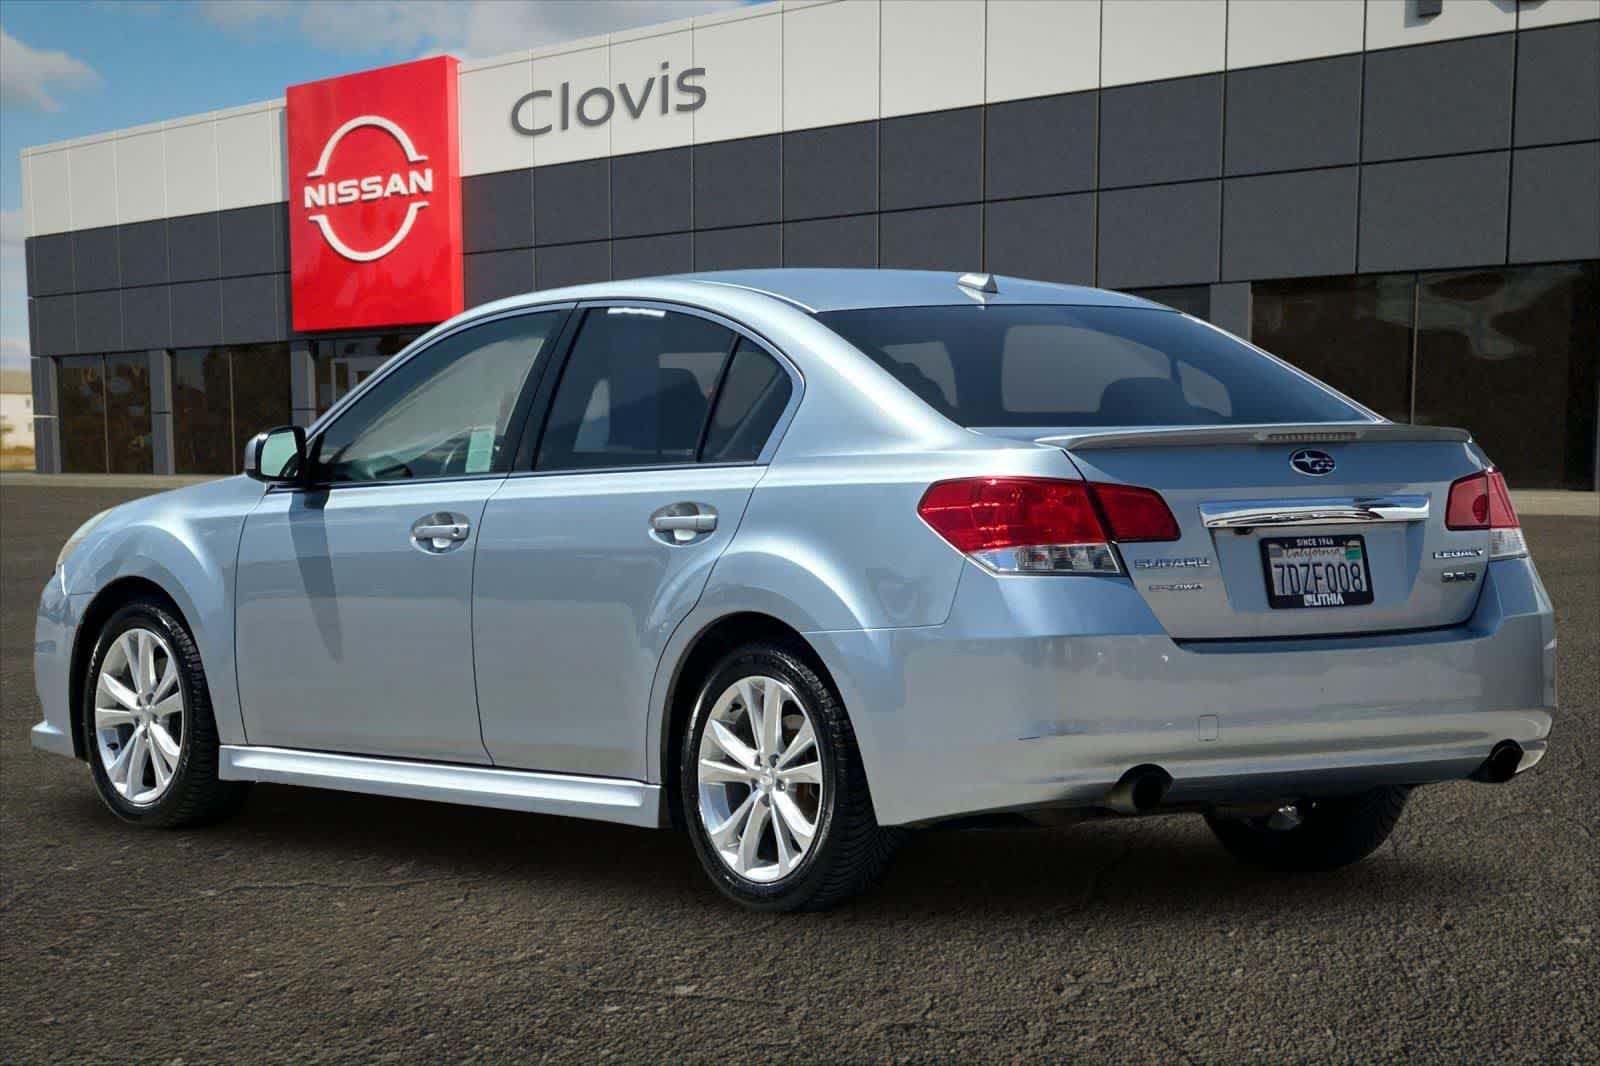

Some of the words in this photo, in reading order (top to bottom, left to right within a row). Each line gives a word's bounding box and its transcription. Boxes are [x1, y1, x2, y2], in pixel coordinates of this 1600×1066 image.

[511, 61, 707, 136] Clovis
[303, 169, 433, 209] NISSAN
[1296, 538, 1317, 547] SINCE
[1135, 558, 1210, 568] SUBARU
[1274, 563, 1363, 594] 7DZF008
[1312, 593, 1344, 606] LITHIA
